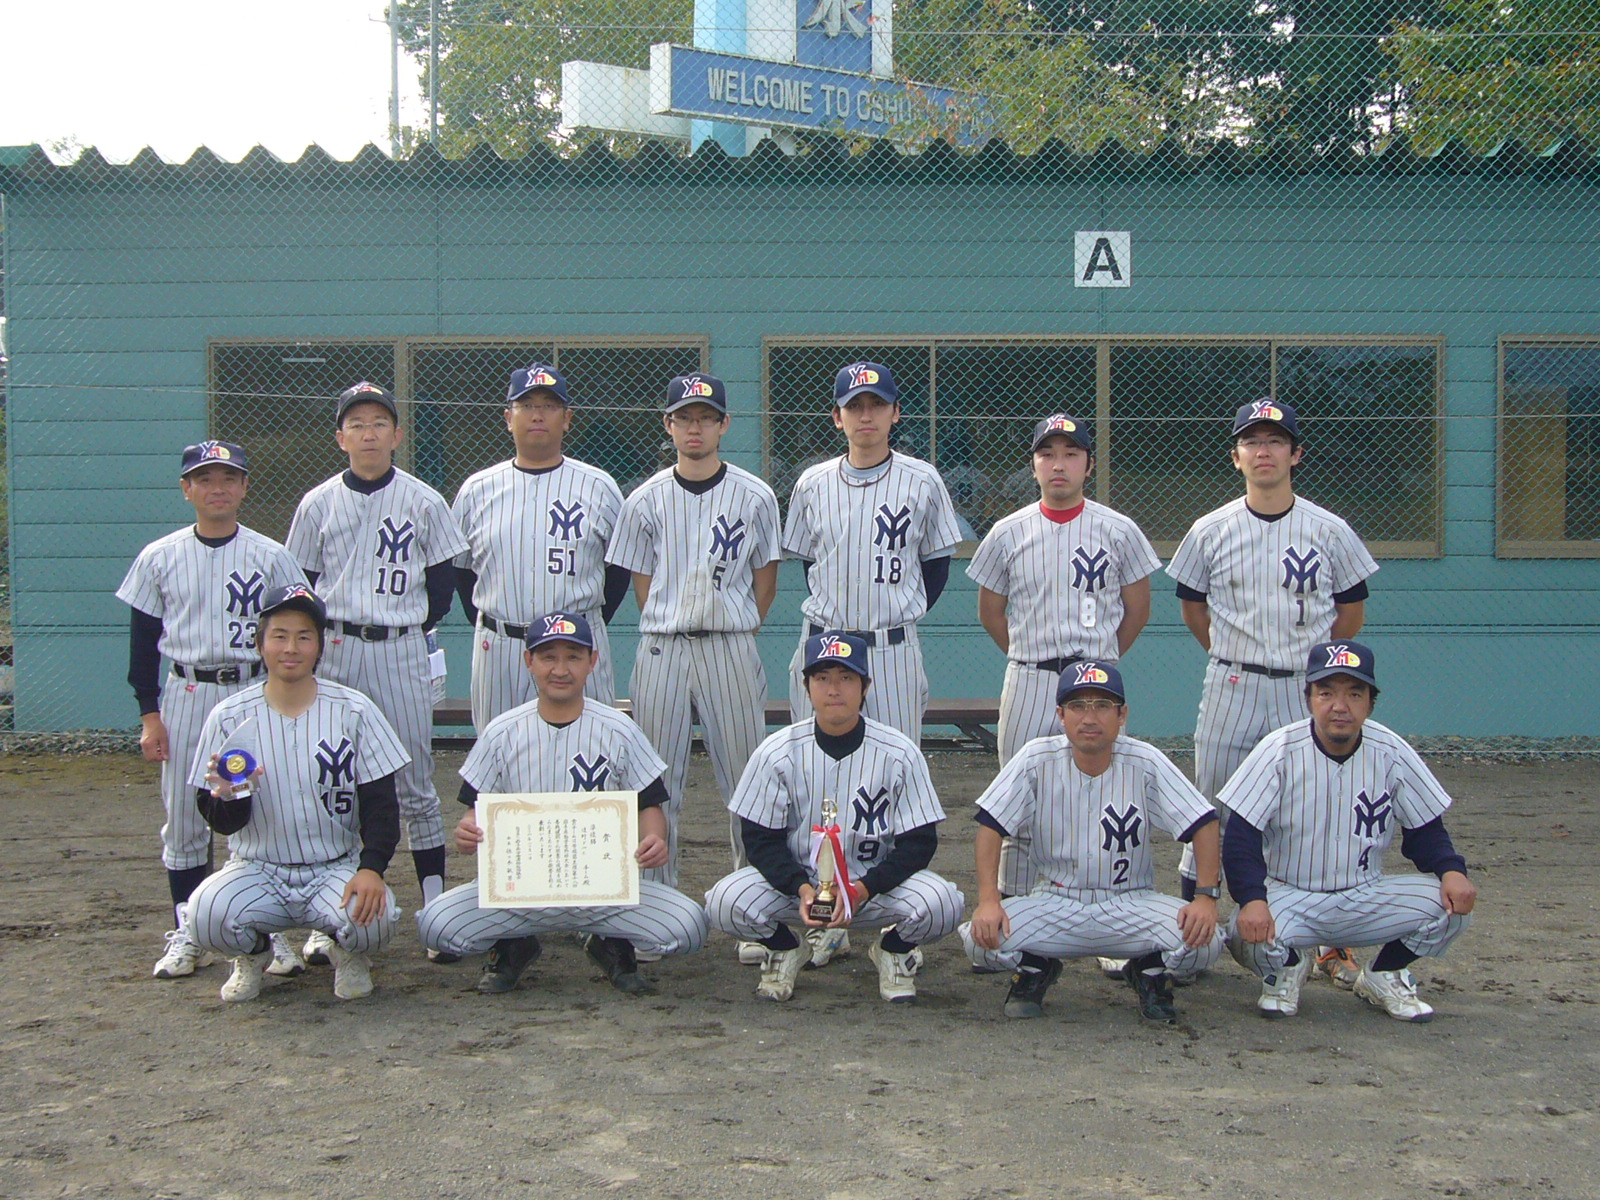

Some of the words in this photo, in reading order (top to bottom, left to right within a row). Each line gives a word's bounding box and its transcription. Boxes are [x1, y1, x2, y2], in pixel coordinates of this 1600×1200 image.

[707, 66, 814, 115] WELCOME
[821, 84, 851, 118] TO
[1083, 237, 1122, 281] A
[548, 547, 577, 577] 51
[874, 554, 902, 585] 18
[375, 567, 407, 596] 10
[1080, 596, 1098, 628] 8
[1294, 599, 1305, 628] 1
[230, 621, 258, 650] 23
[857, 840, 880, 861] 9
[1112, 858, 1130, 886] 2
